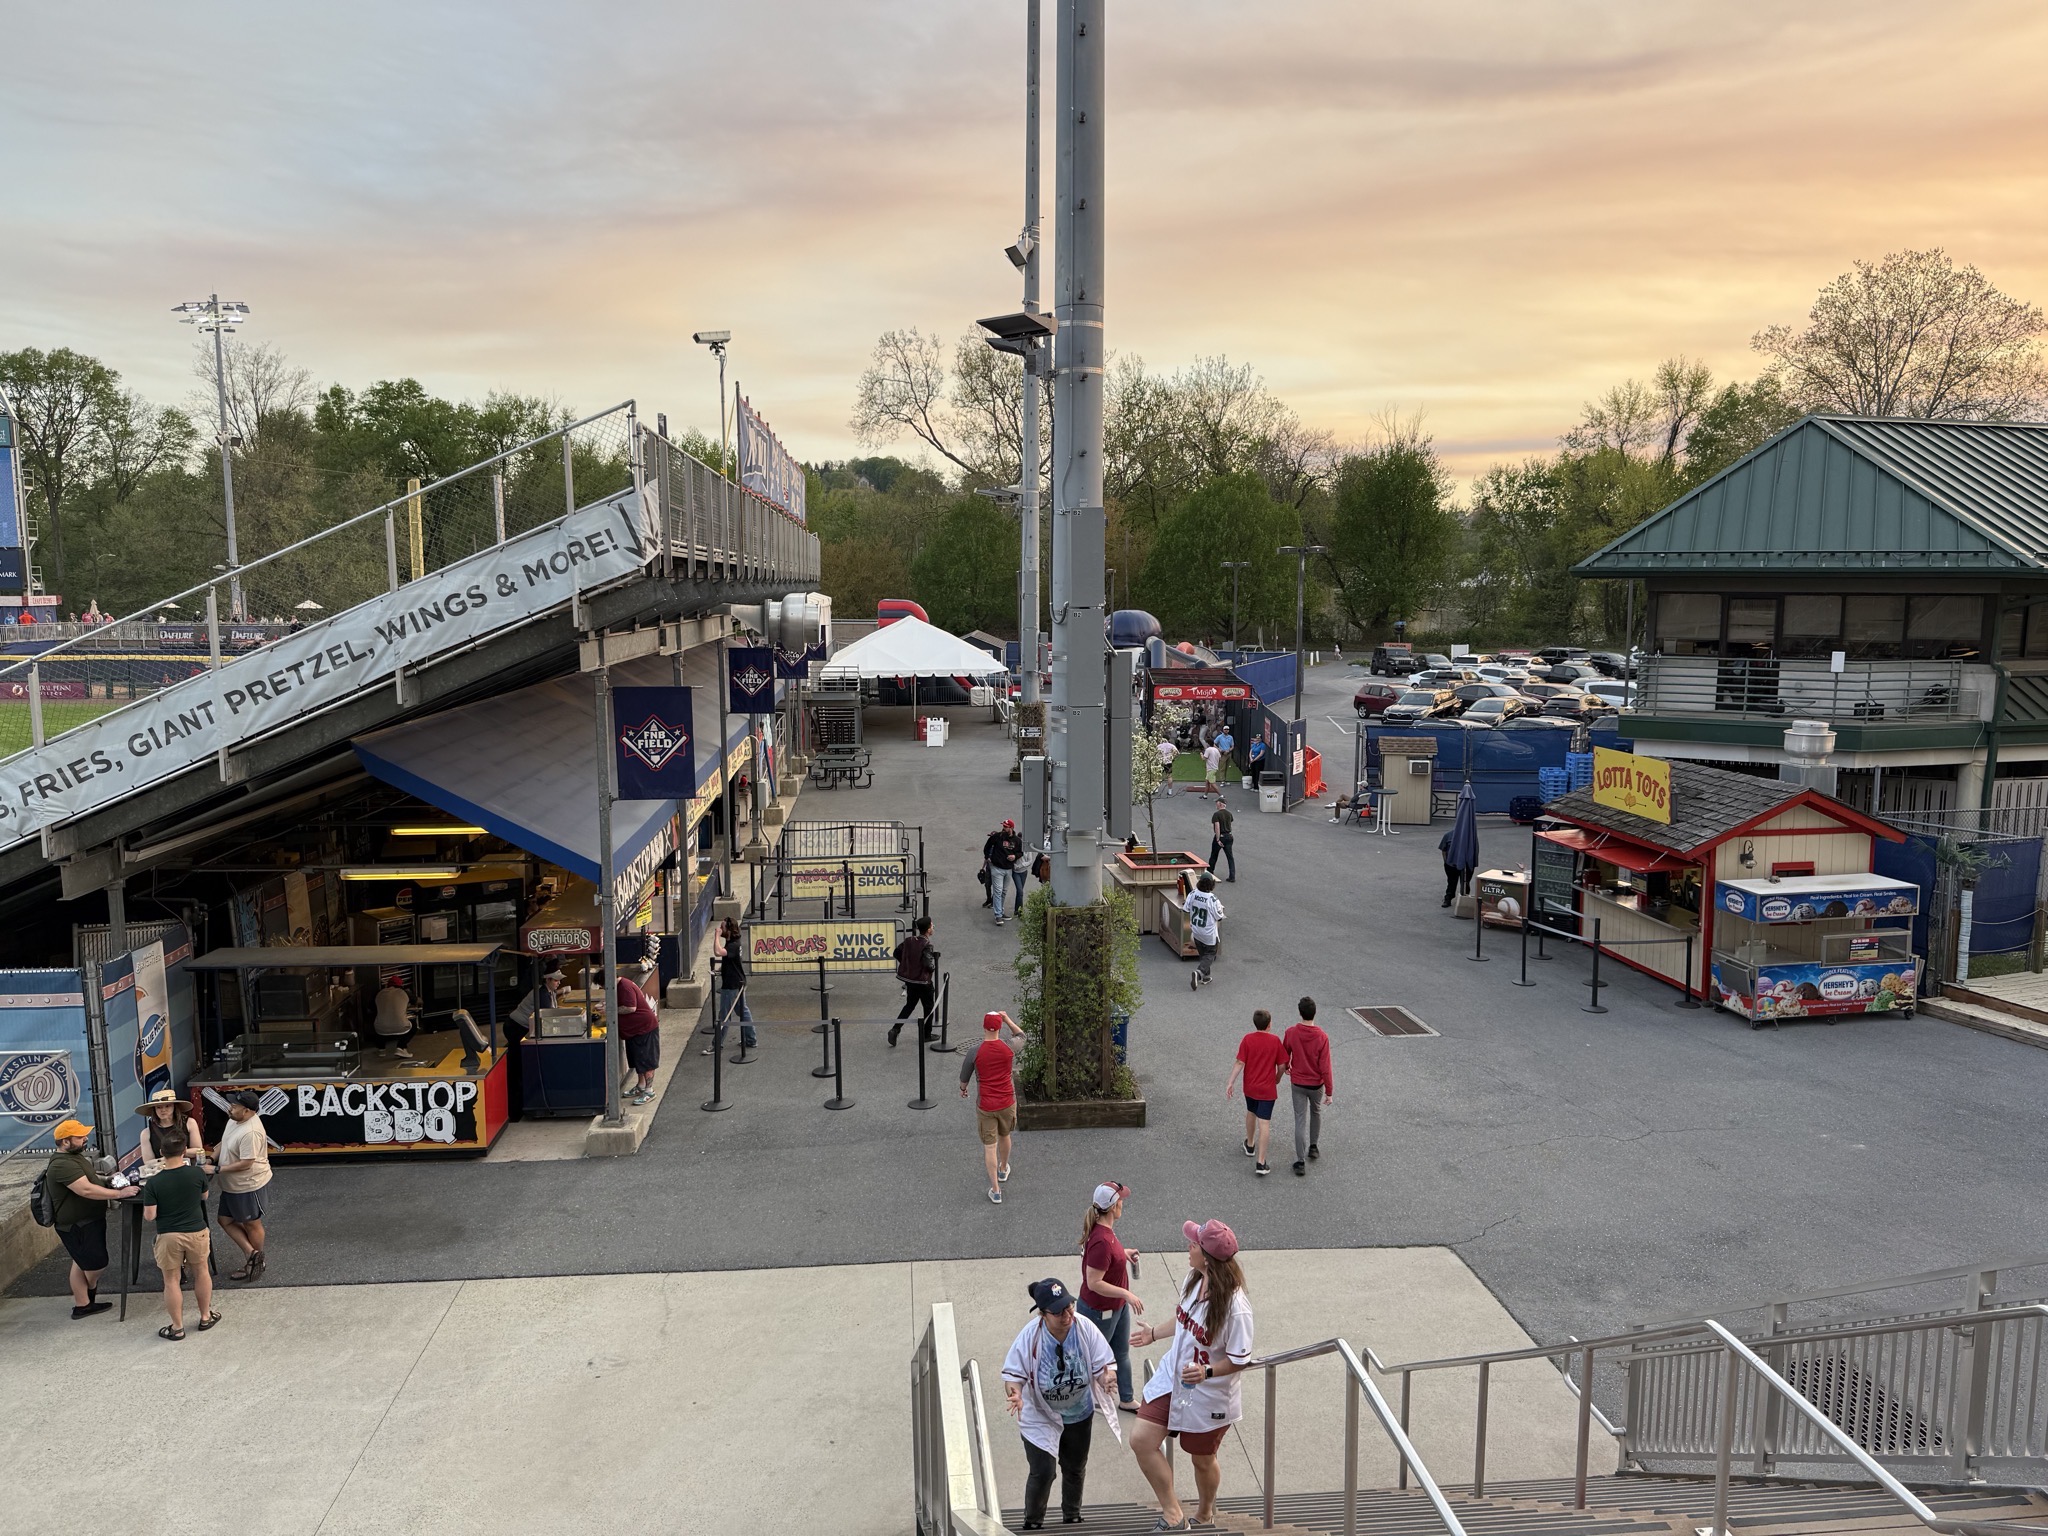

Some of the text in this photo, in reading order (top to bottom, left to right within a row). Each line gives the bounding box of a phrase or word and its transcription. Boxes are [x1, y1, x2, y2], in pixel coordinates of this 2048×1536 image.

[18, 751, 124, 806] FRIES,
[128, 700, 216, 757] GIANT
[224, 640, 375, 715] PRETZEL,
[374, 584, 488, 646] WINGS
[496, 574, 518, 598] &
[522, 528, 618, 586] MORE!
[644, 730, 665, 740] FNB
[638, 738, 673, 749] FIELD
[1596, 766, 1666, 809] LOTTA TOTS
[861, 865, 900, 875] WING
[617, 845, 650, 911] BACKSTOP
[858, 875, 904, 887] SHACK
[1482, 886, 1506, 895] ULTRA
[1192, 906, 1208, 928] 29
[530, 931, 590, 947] SENATORS
[754, 934, 827, 955] AROOGA'S
[836, 933, 884, 946] WING
[833, 947, 891, 959] SHACK
[1824, 981, 1854, 989] HERSHEY'S
[298, 1081, 476, 1117] BACKSTOP
[364, 1108, 457, 1144] BBQ
